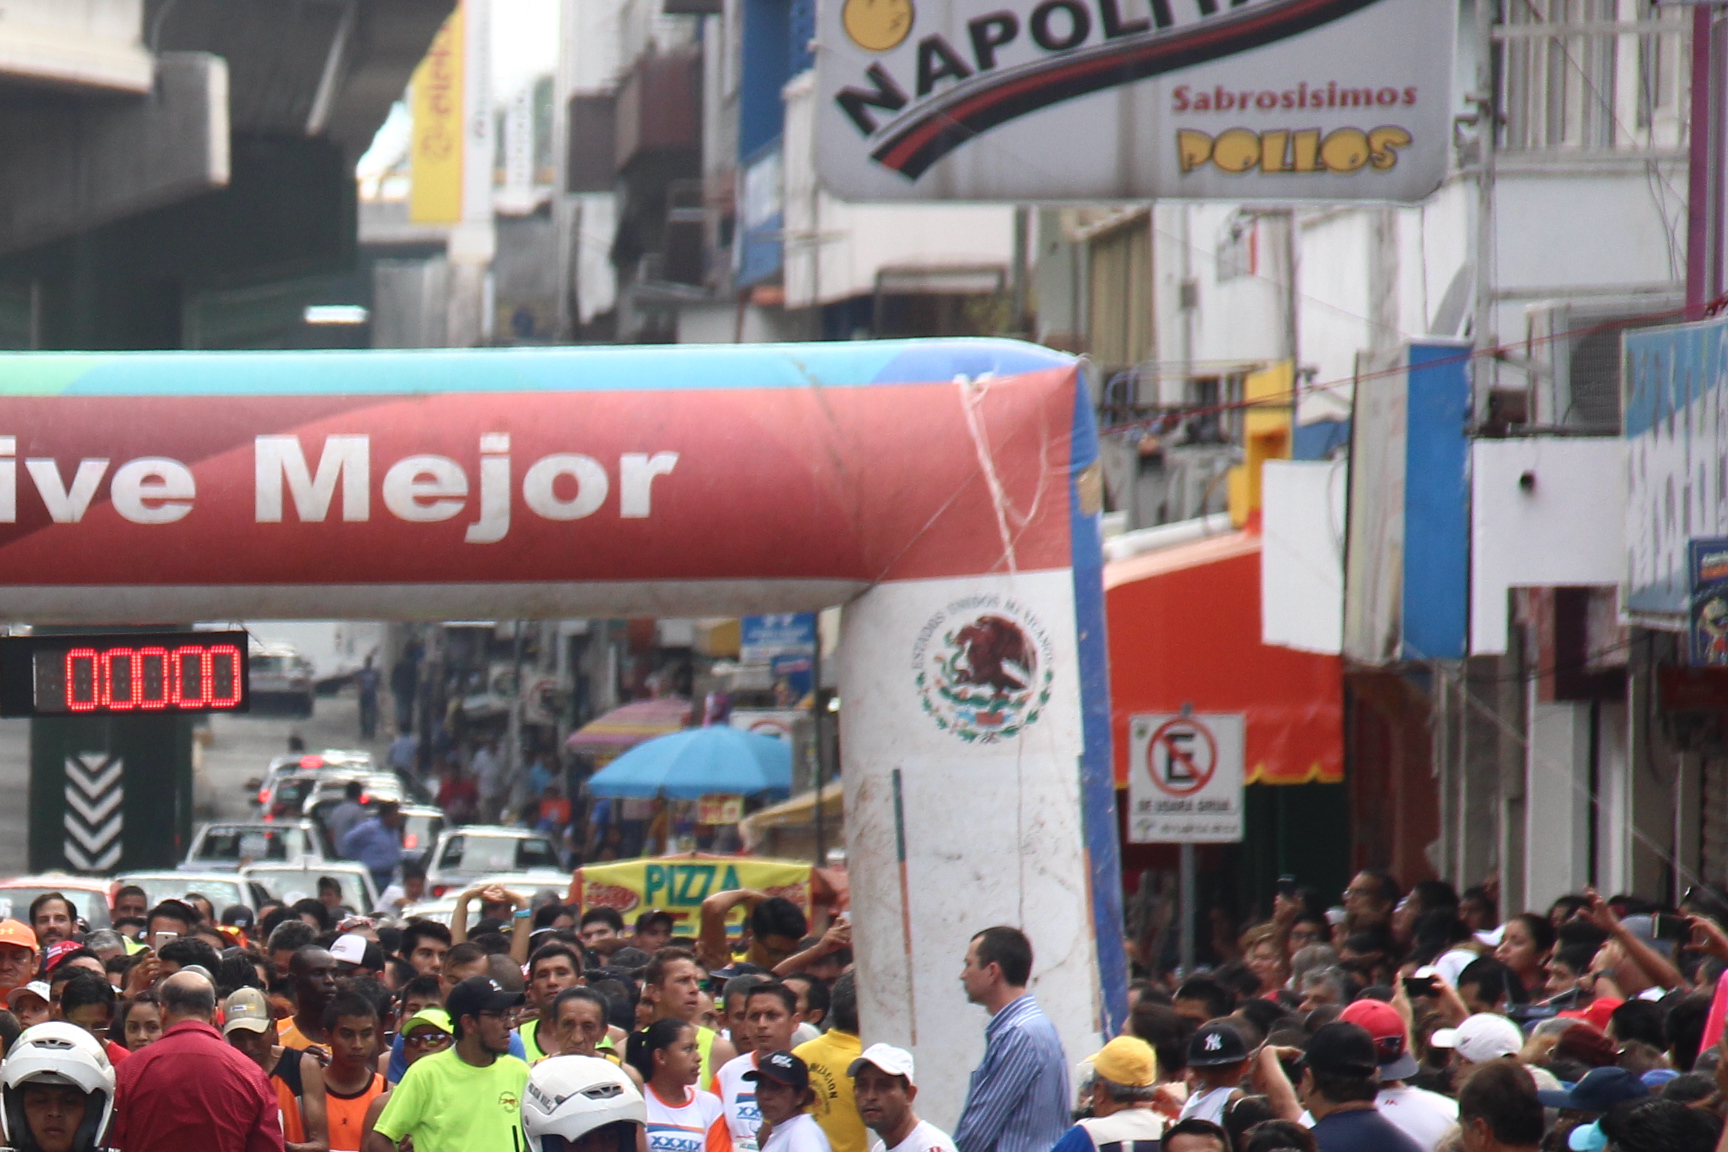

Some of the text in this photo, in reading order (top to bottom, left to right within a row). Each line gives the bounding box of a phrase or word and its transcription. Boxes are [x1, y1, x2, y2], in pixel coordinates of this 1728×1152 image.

[1173, 81, 1417, 111] Sabrosisimos
[1179, 125, 1412, 174] POLLOS
[255, 432, 681, 544] Mejor
[645, 864, 741, 907] PIZZA
